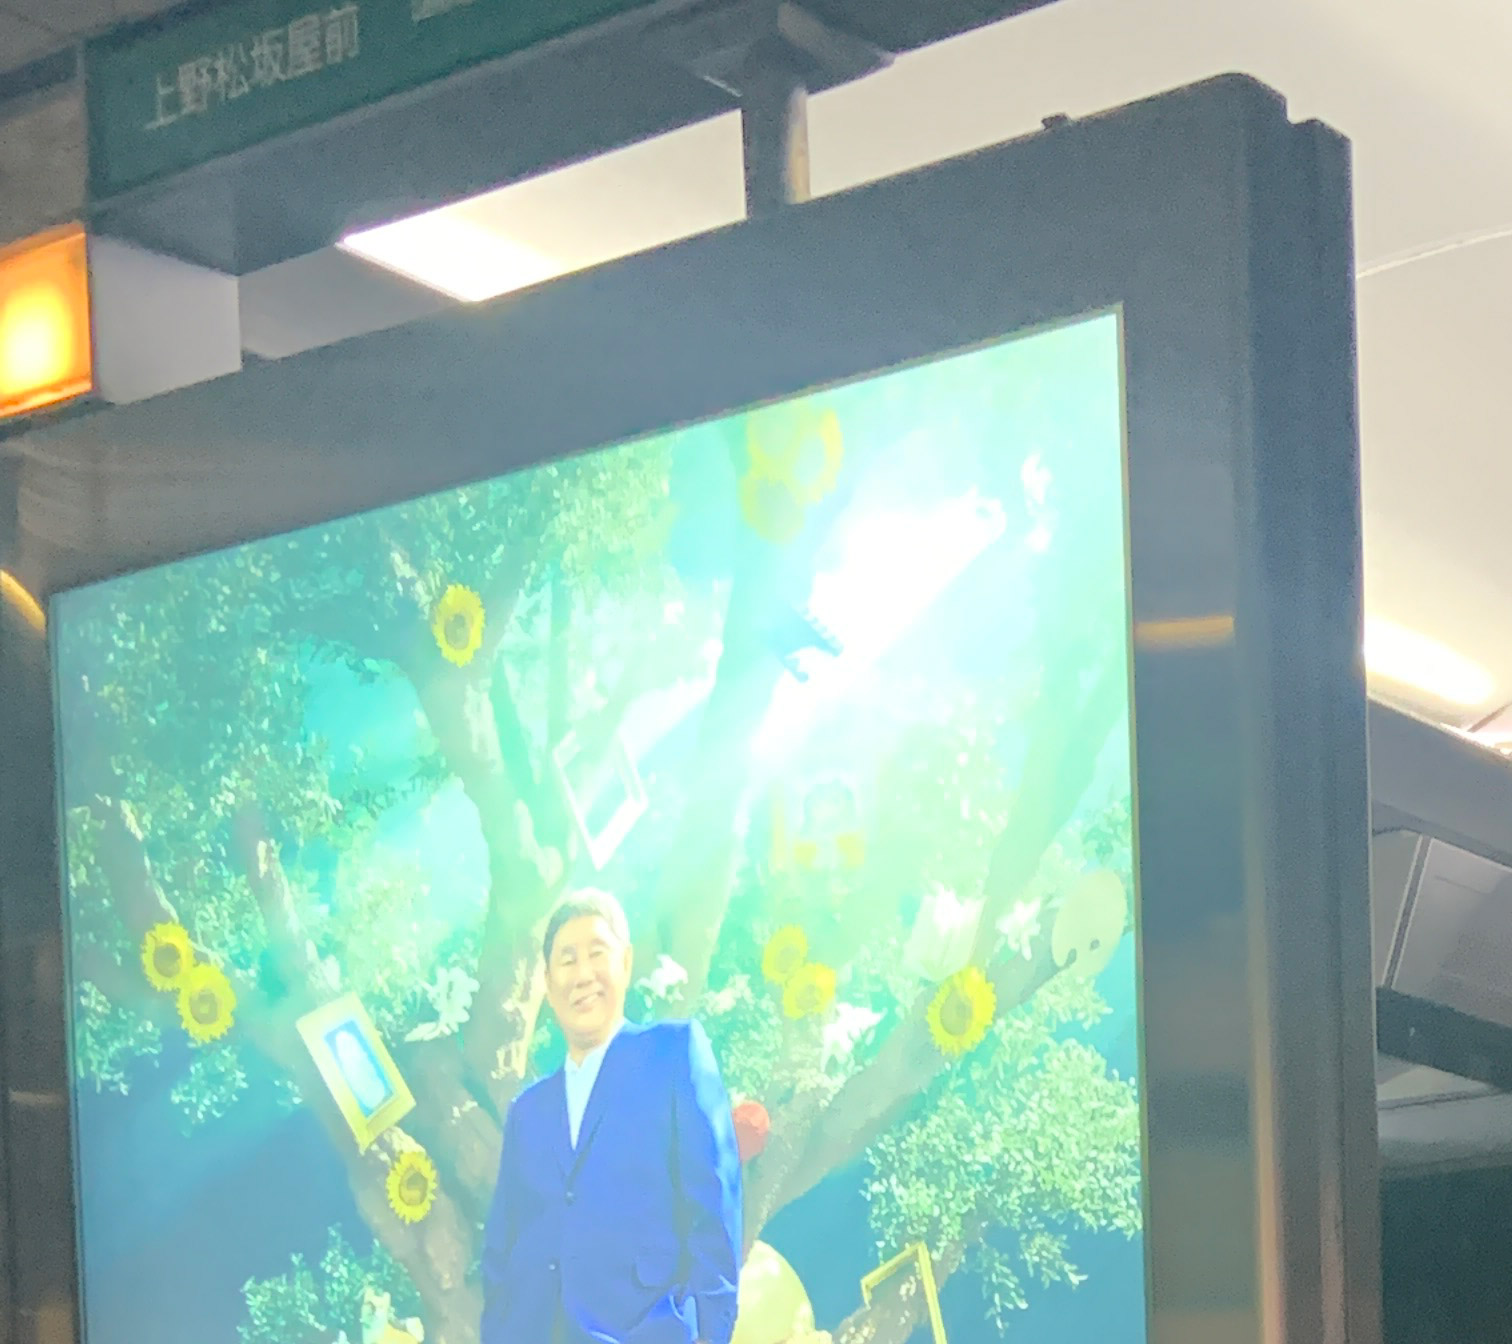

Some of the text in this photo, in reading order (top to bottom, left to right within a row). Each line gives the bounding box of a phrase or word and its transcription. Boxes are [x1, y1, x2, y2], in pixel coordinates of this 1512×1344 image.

[144, 4, 359, 130] 上野松坂屋前
